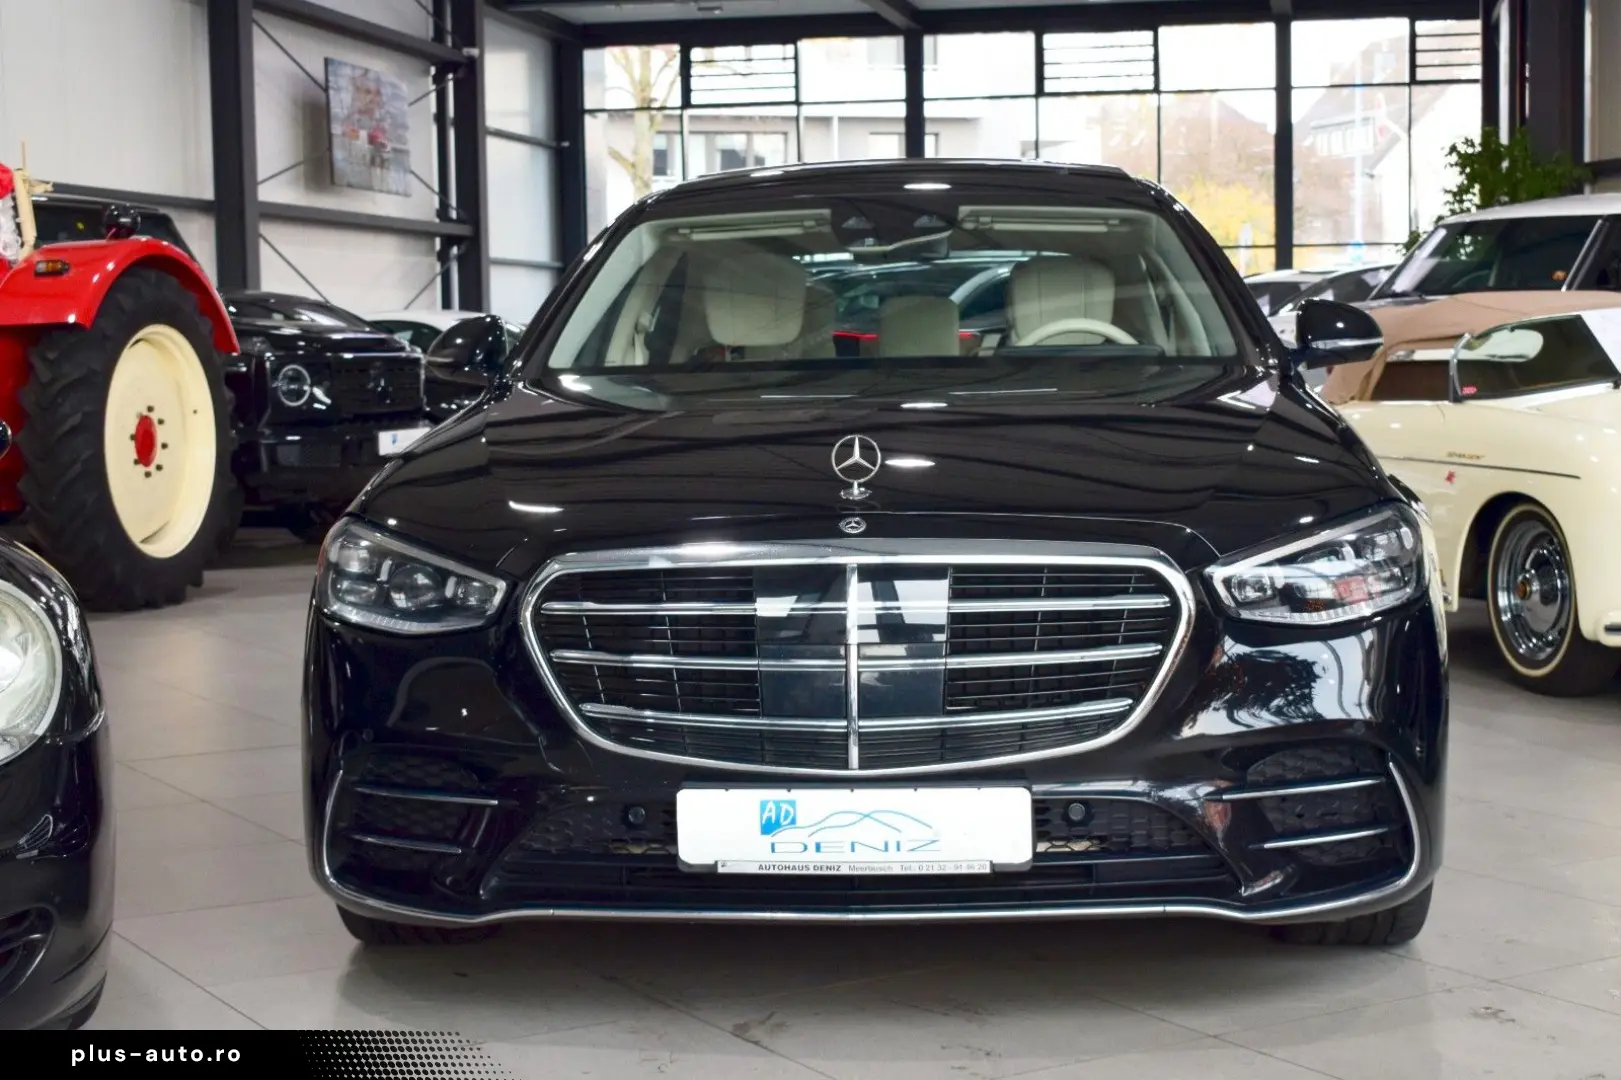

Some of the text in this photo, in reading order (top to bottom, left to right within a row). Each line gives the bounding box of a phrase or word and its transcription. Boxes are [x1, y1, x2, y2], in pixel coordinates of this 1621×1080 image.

[762, 800, 794, 825] AD
[770, 839, 941, 854] DENIZ
[758, 864, 811, 872] AUTOHAUS
[813, 864, 842, 872] DENIZ
[848, 864, 894, 872] Meerbusch
